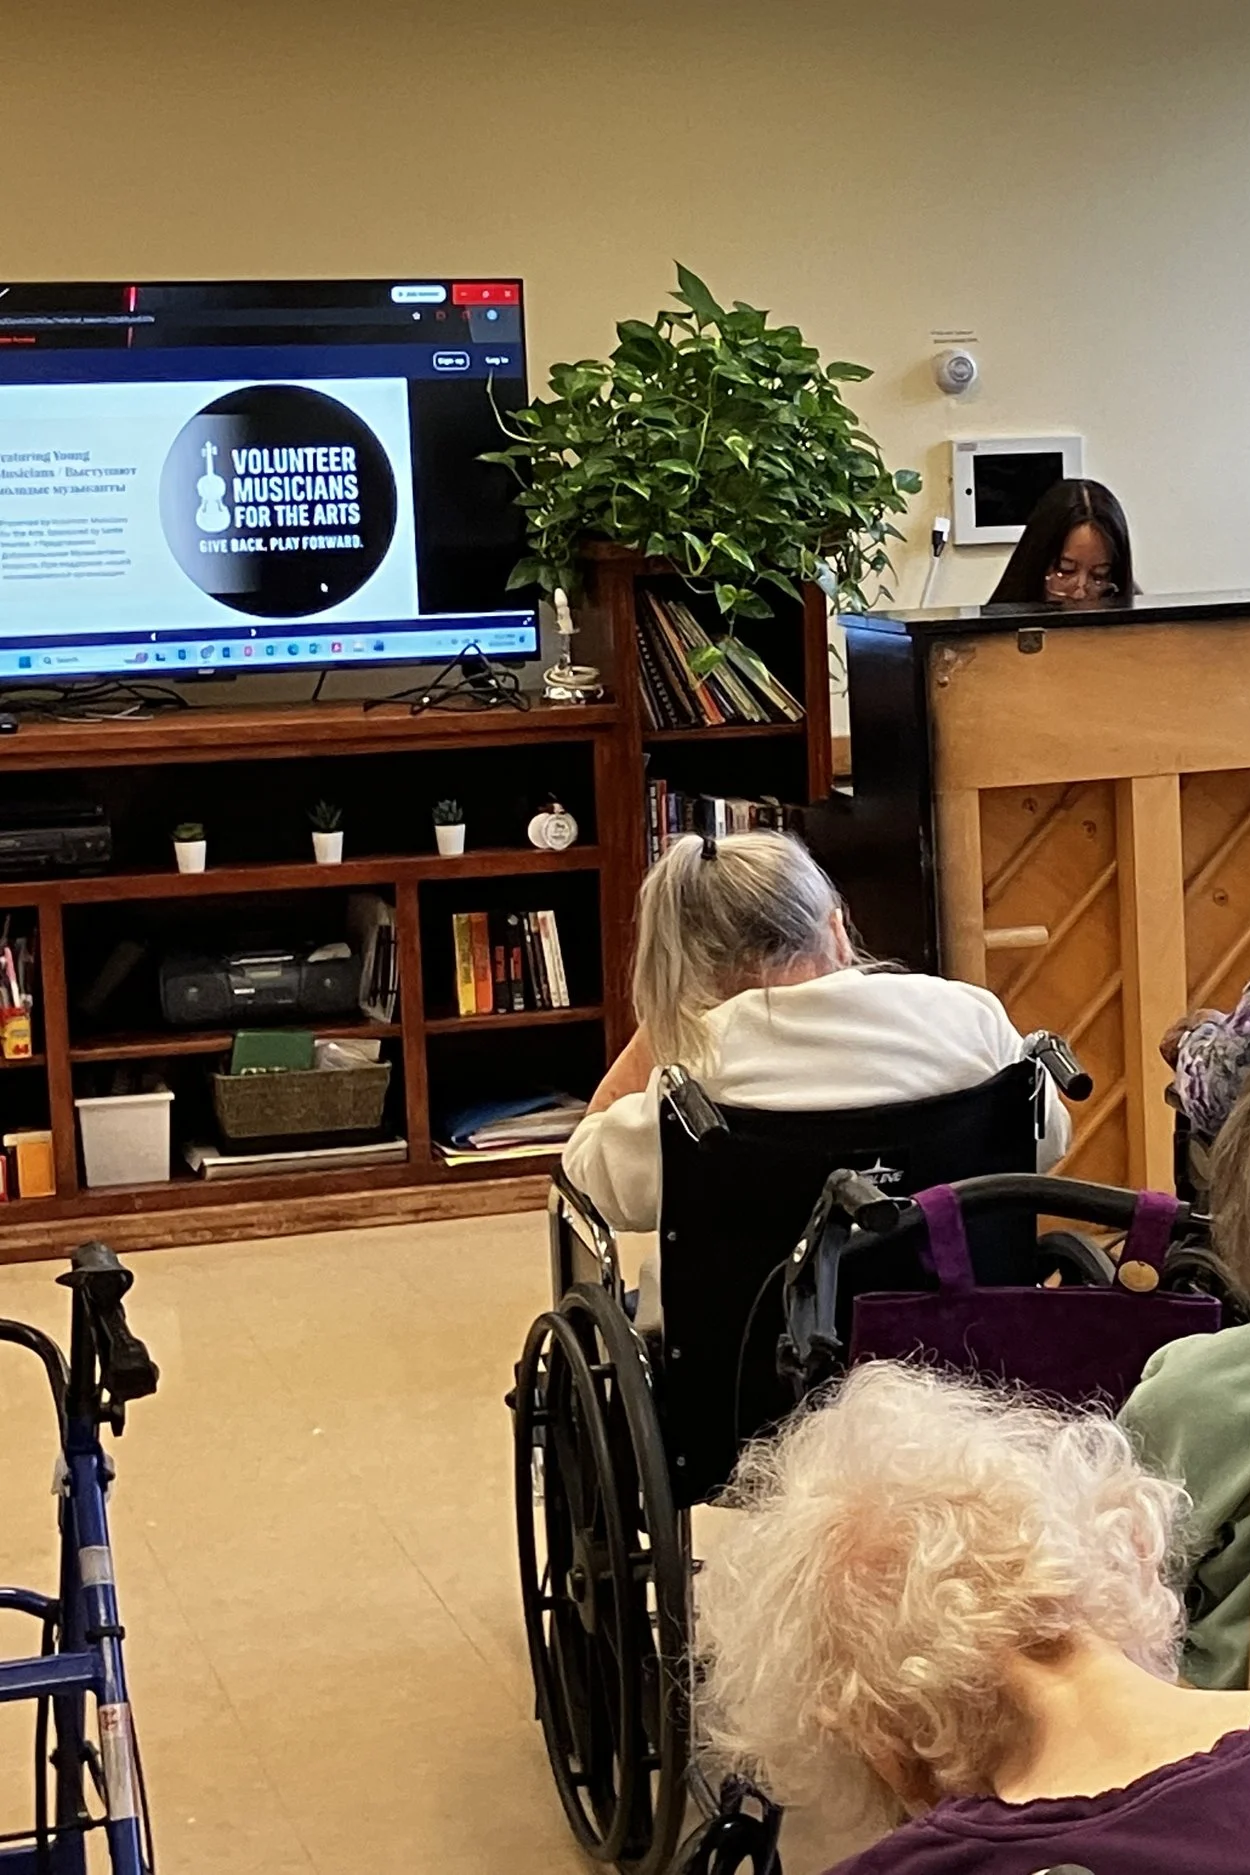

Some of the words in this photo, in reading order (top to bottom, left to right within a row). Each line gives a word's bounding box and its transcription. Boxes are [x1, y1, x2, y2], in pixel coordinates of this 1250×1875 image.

[0, 452, 51, 463] eaturing
[53, 450, 90, 463] Young
[231, 447, 357, 475] VOLUNTEER
[232, 475, 359, 503] MUSICIANS
[234, 506, 272, 528] FOR
[274, 504, 310, 526] THE
[313, 502, 361, 525] ARTS
[200, 540, 228, 553] GIVE
[270, 537, 300, 550] PLAY
[301, 535, 364, 550] FORWARD.
